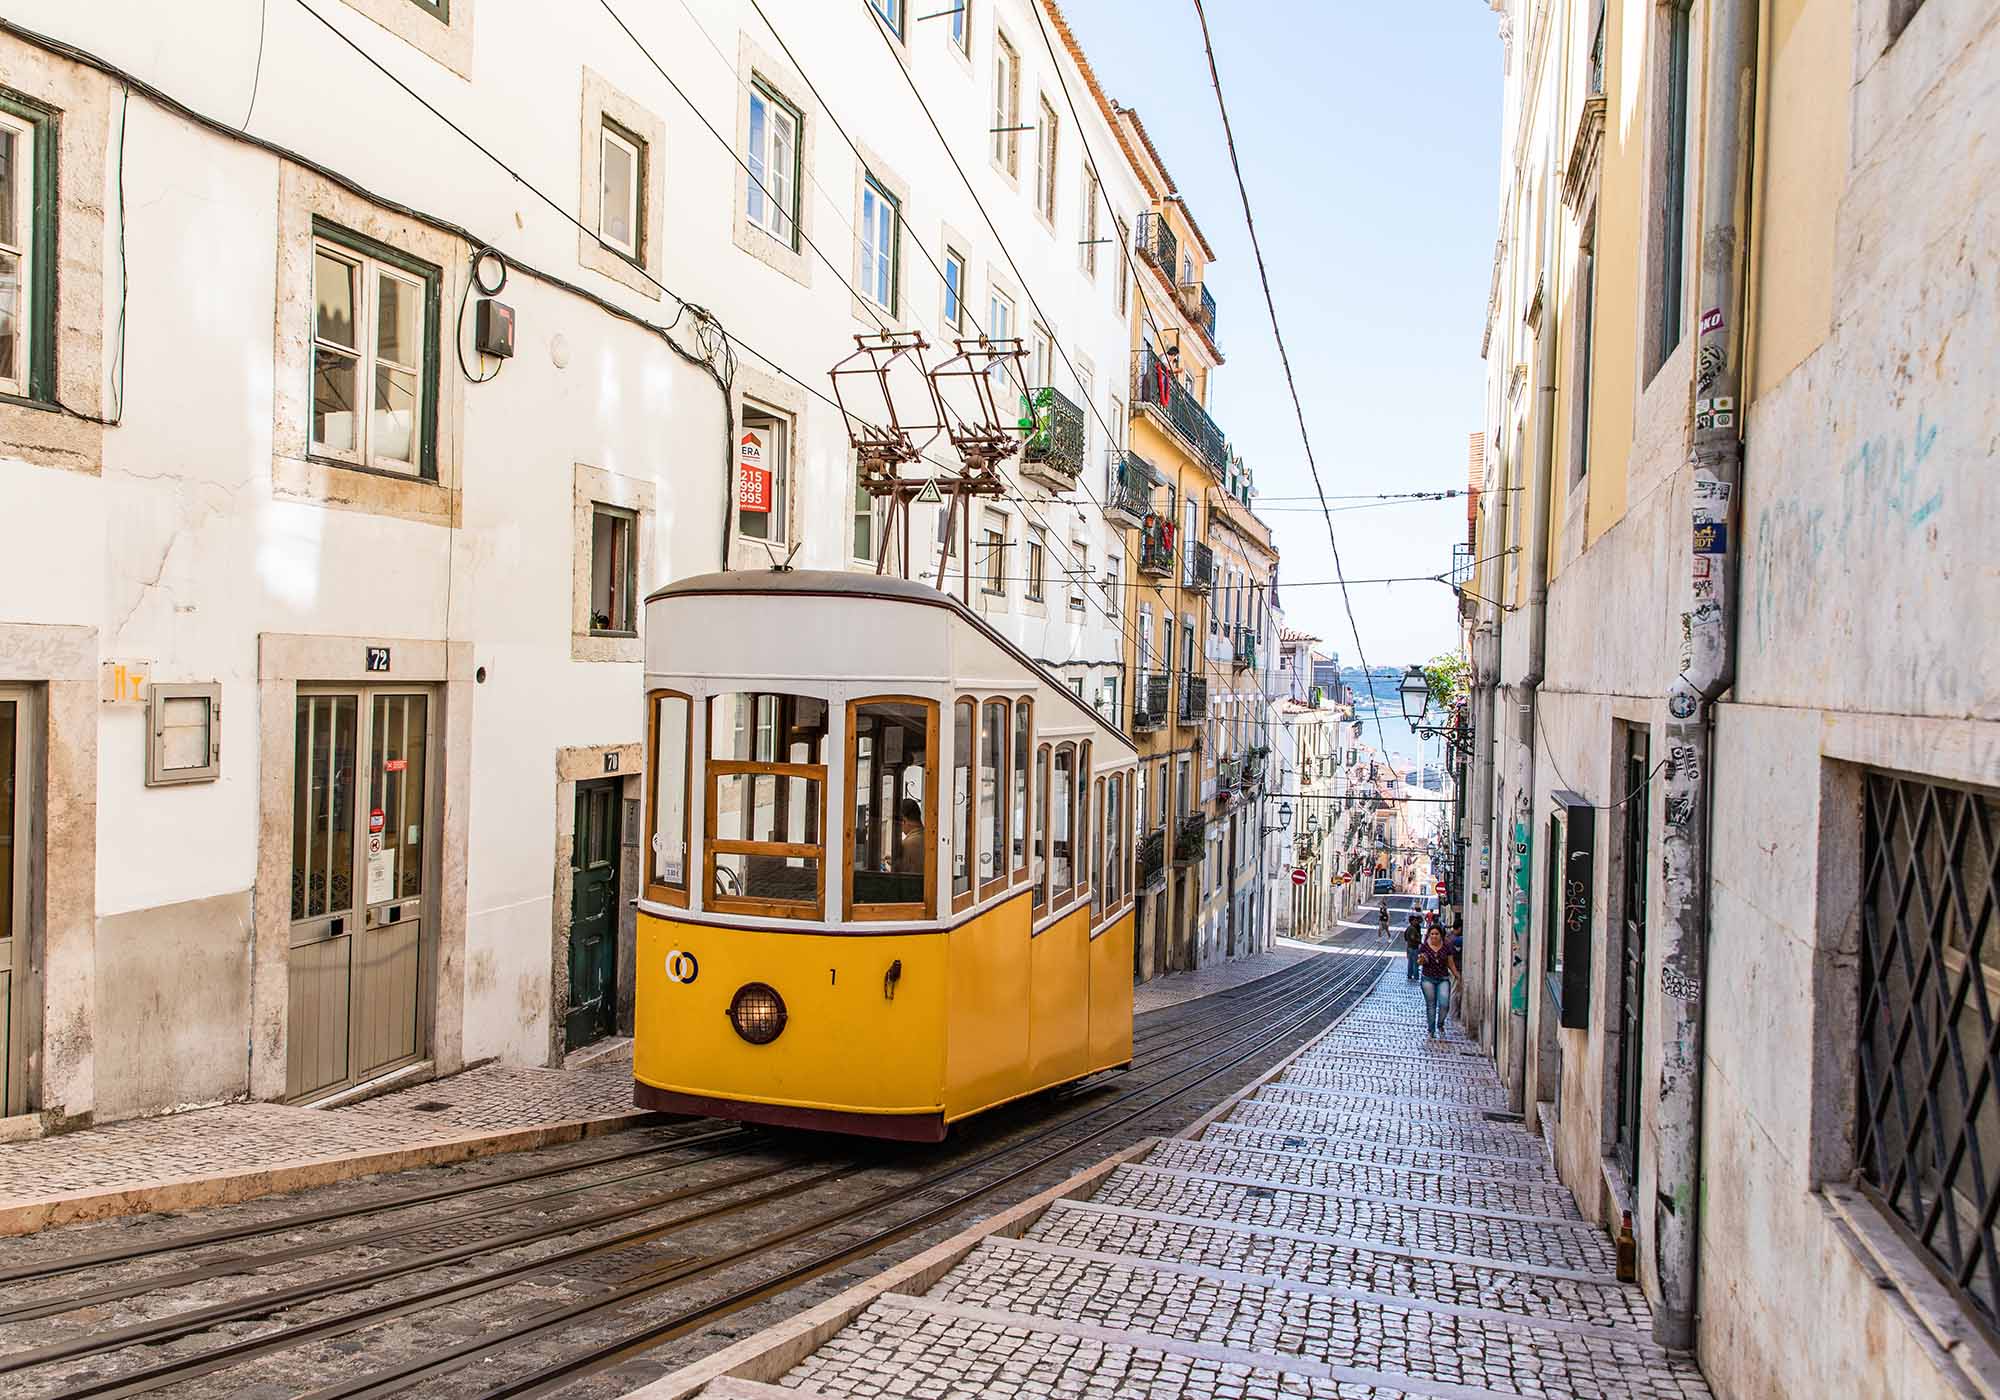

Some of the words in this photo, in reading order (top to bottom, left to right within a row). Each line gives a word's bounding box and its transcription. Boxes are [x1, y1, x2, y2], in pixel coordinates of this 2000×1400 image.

[741, 446, 760, 456] ERA
[741, 470, 762, 482] 215
[740, 480, 762, 493] 999
[740, 491, 762, 504] 995
[371, 649, 387, 670] 72
[607, 754, 618, 770] 70
[829, 968, 836, 986] 1
